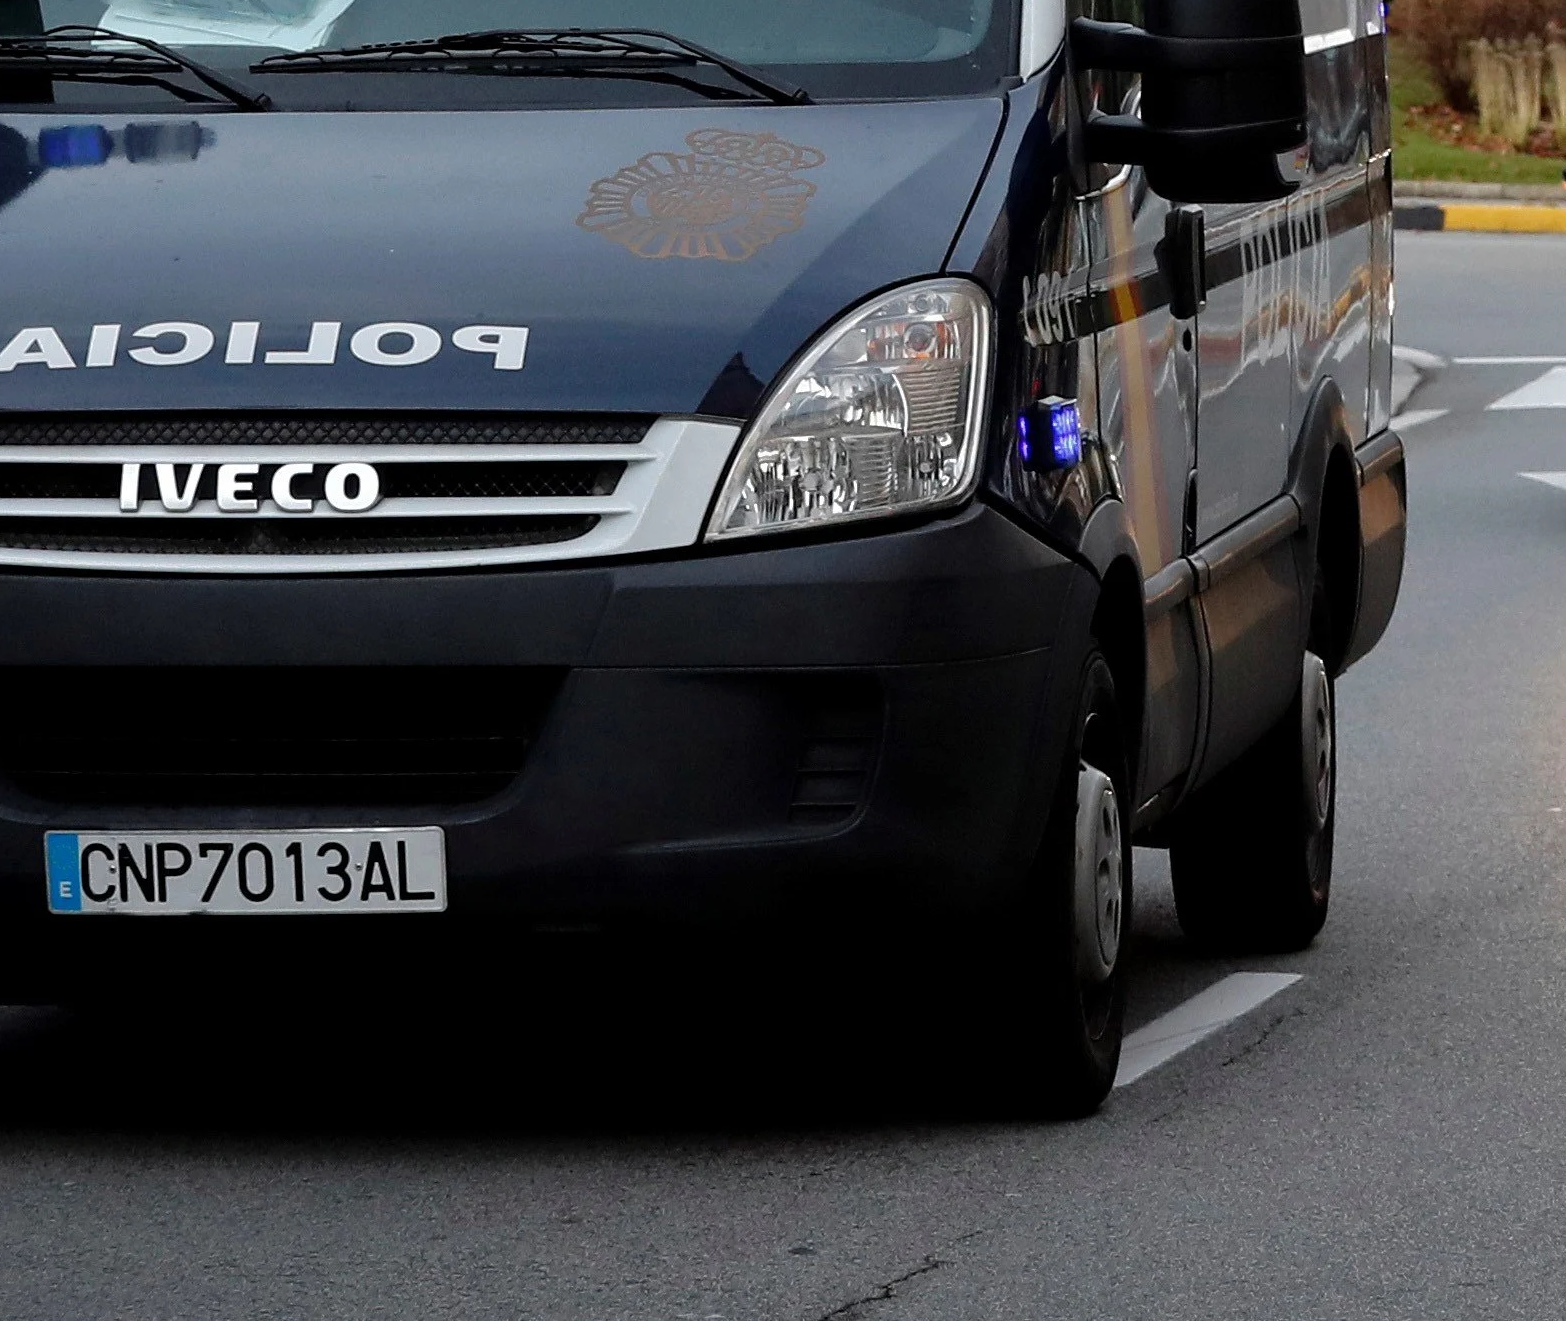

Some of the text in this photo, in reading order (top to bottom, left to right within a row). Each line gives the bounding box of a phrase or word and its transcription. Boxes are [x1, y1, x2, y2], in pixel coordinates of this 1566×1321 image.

[119, 462, 382, 514] IVECO
[58, 840, 436, 904] E CNP7013AL
